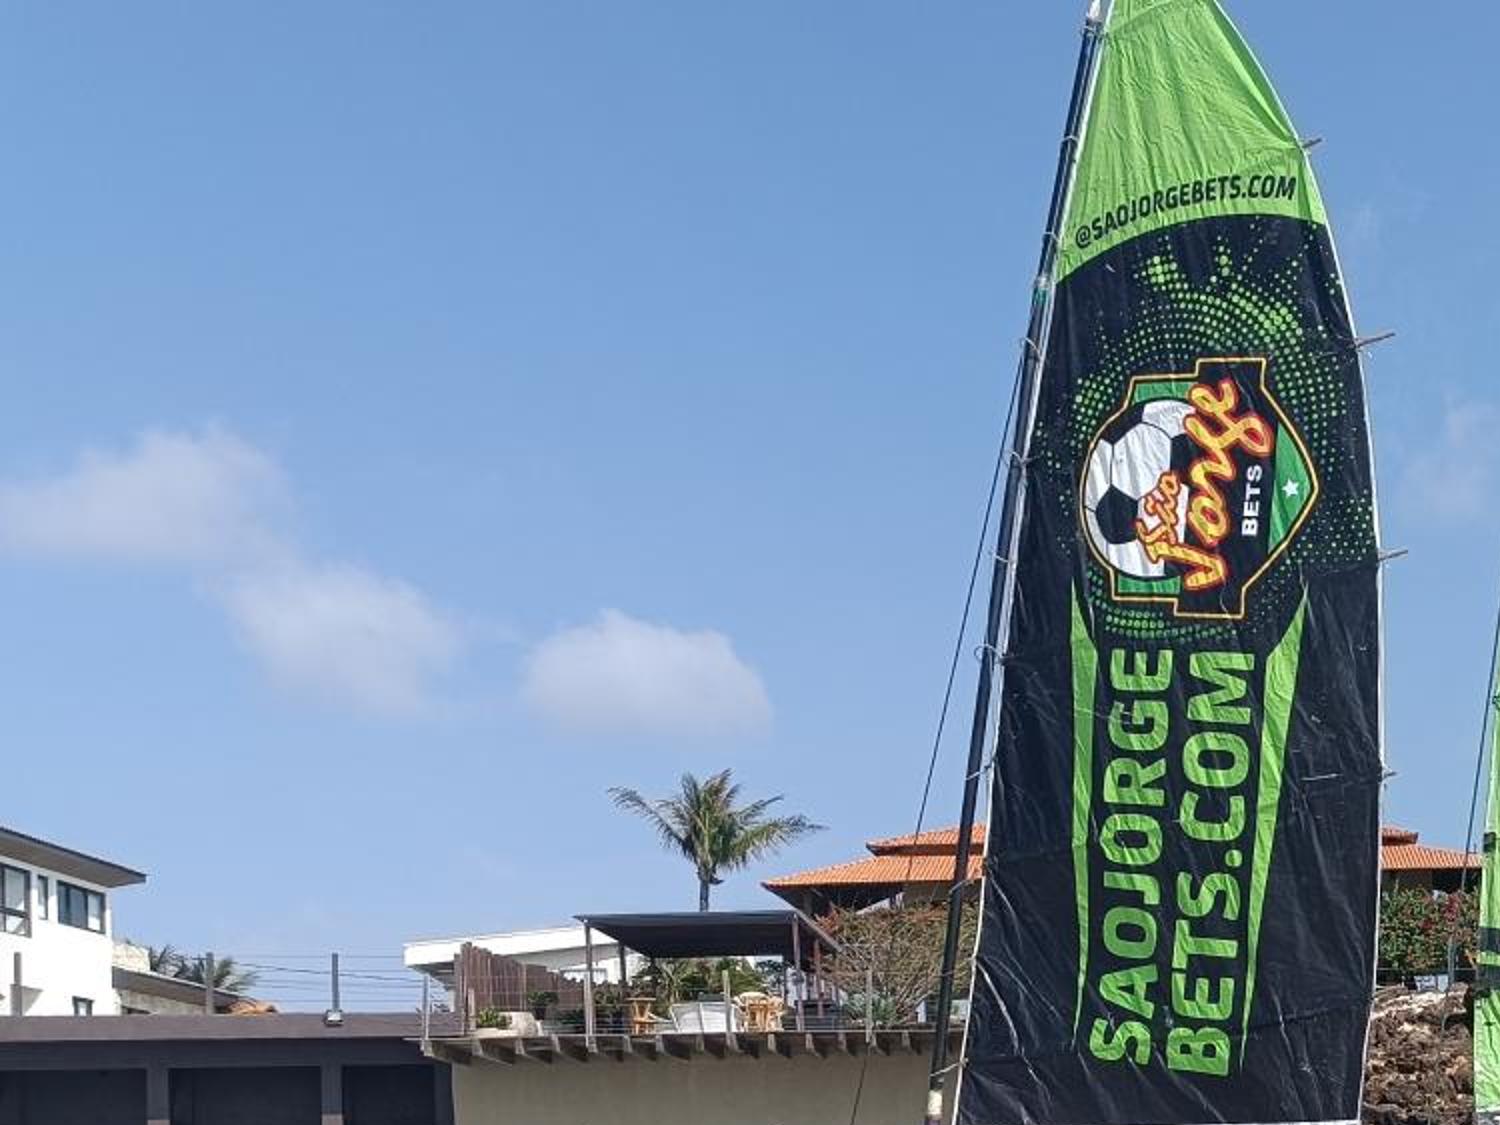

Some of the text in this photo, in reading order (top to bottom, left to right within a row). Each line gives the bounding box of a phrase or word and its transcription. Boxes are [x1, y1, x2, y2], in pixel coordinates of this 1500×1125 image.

[1075, 174, 1298, 249] @SAOJORGEBETS.COM
[1149, 377, 1274, 591] Jorge
[1241, 464, 1264, 538] BETS
[1088, 648, 1174, 1066] SAOJORGE
[1166, 650, 1256, 1078] BETS.COM
